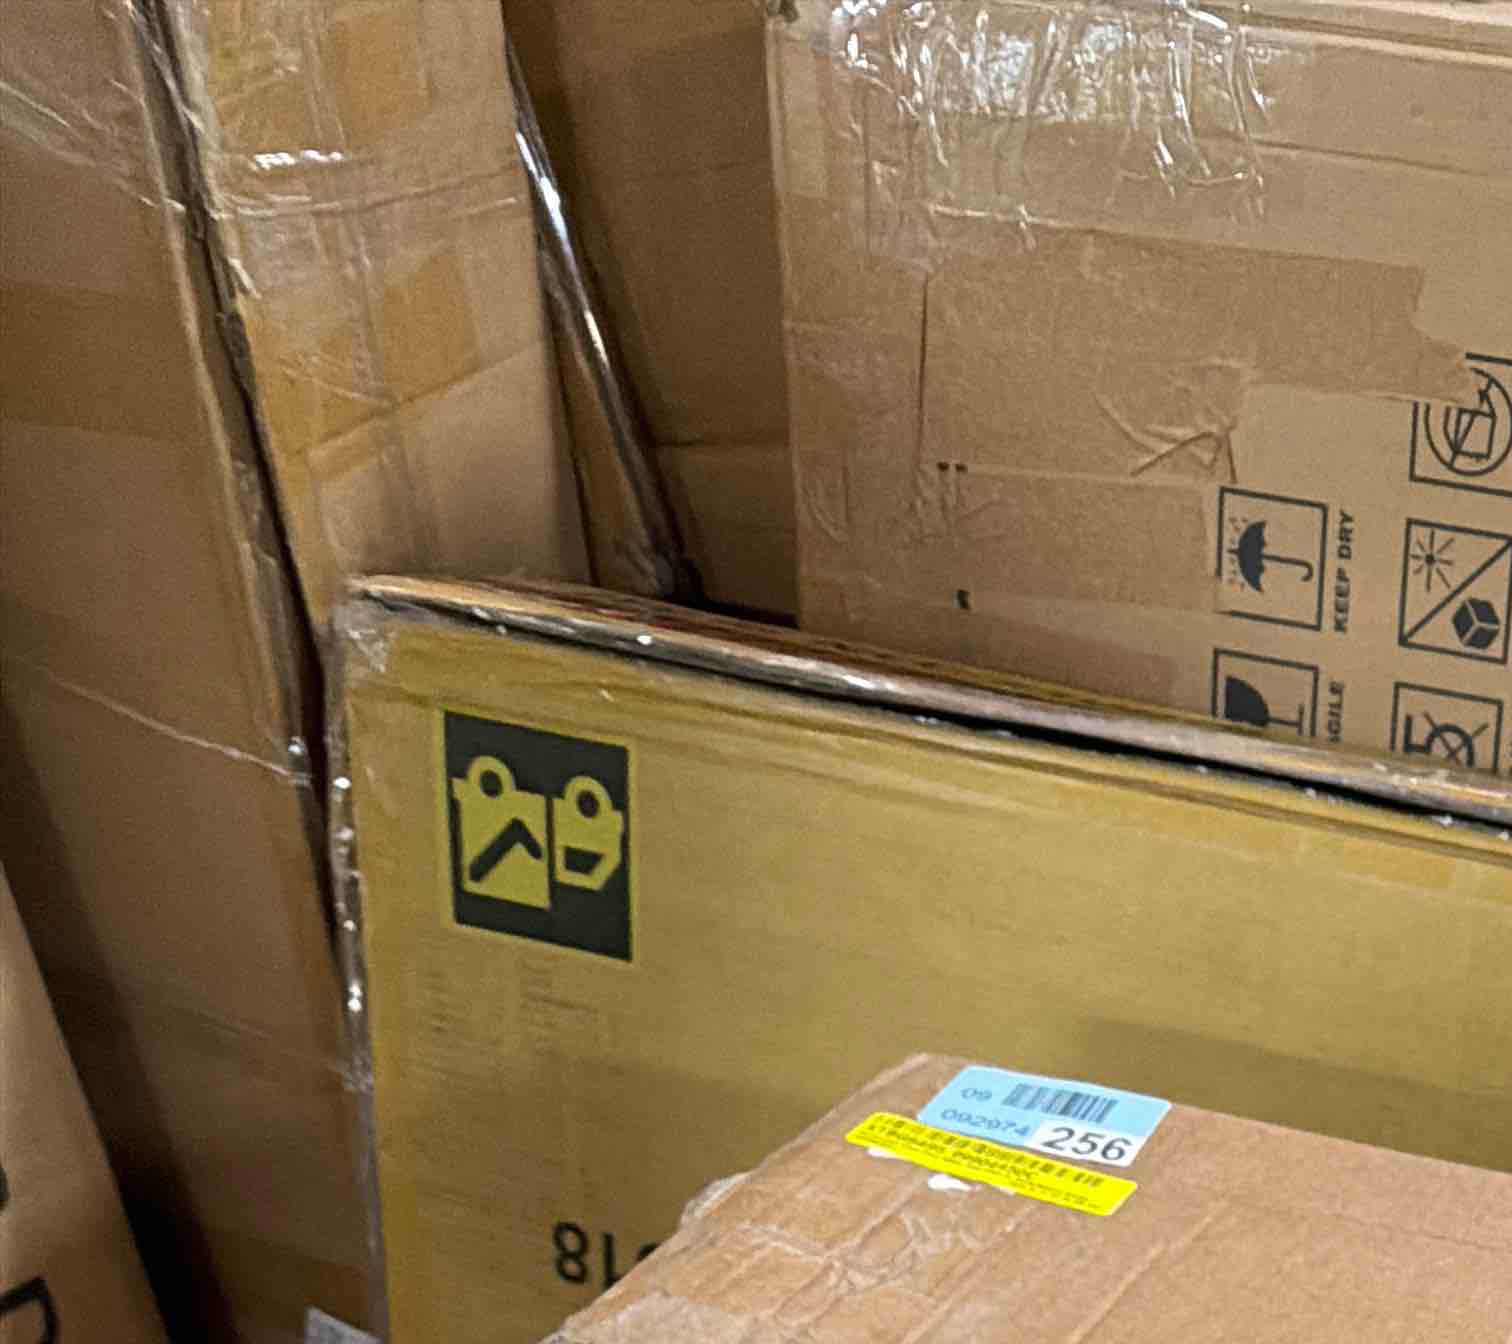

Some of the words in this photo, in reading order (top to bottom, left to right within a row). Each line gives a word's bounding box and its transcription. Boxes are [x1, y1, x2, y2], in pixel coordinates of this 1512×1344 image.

[1337, 510, 1356, 561] DRY
[1333, 563, 1353, 634] KEEP
[1041, 1126, 1133, 1161] 256
[552, 1221, 659, 1287] 18
